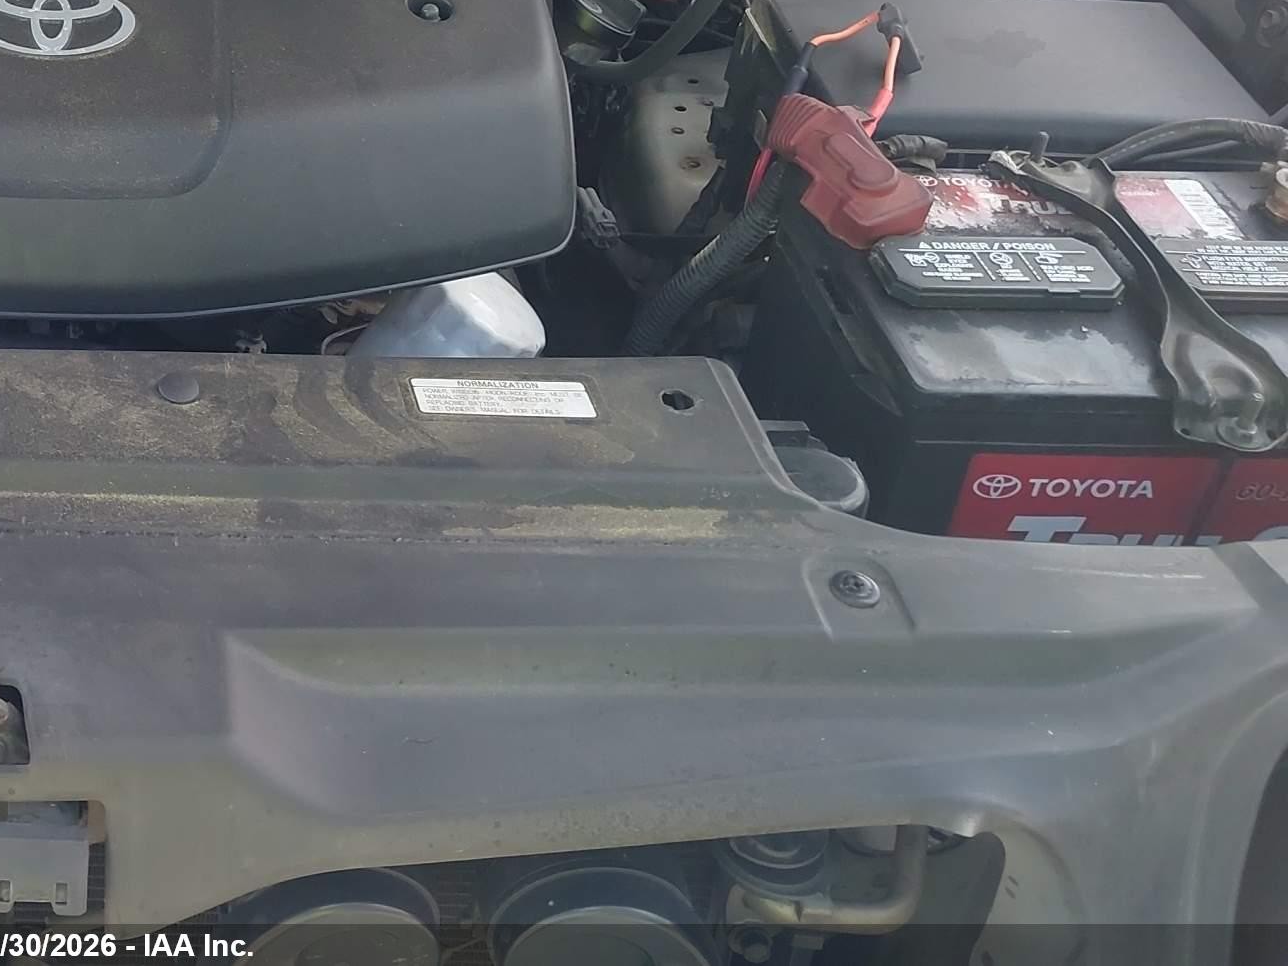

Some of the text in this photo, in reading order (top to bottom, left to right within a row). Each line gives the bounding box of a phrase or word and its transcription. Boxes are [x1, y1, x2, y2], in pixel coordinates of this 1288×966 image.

[931, 242, 991, 250] DANGER
[1001, 243, 1056, 251] POISON
[457, 380, 539, 389] NORMALIZATION
[1028, 478, 1154, 498] TOYOTA
